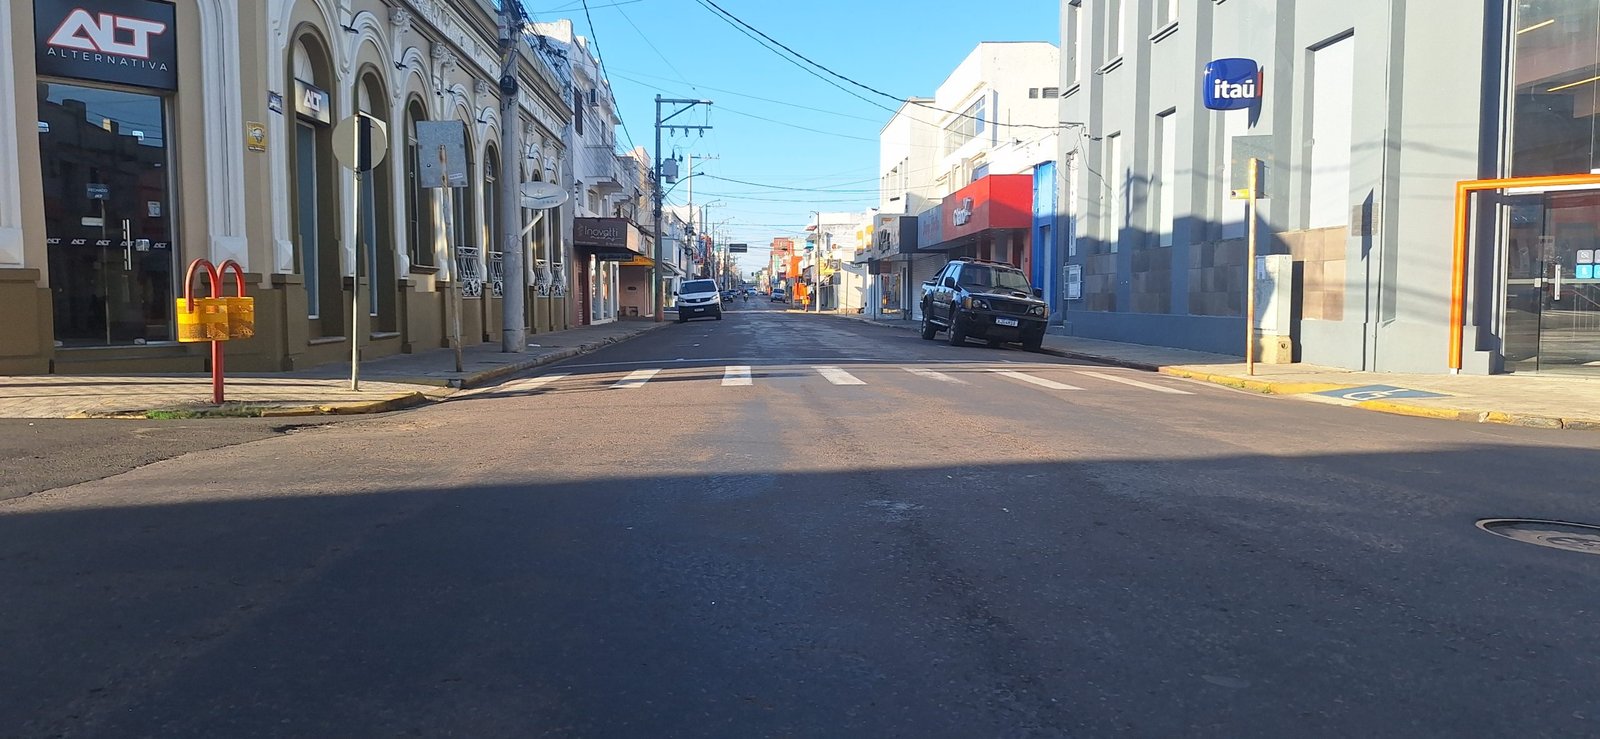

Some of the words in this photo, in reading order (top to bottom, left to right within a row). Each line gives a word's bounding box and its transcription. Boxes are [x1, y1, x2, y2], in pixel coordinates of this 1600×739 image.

[47, 8, 166, 58] ALT
[47, 47, 168, 71] ALTERNATIVA
[303, 88, 322, 112] ALT
[1214, 79, 1254, 99] itaú
